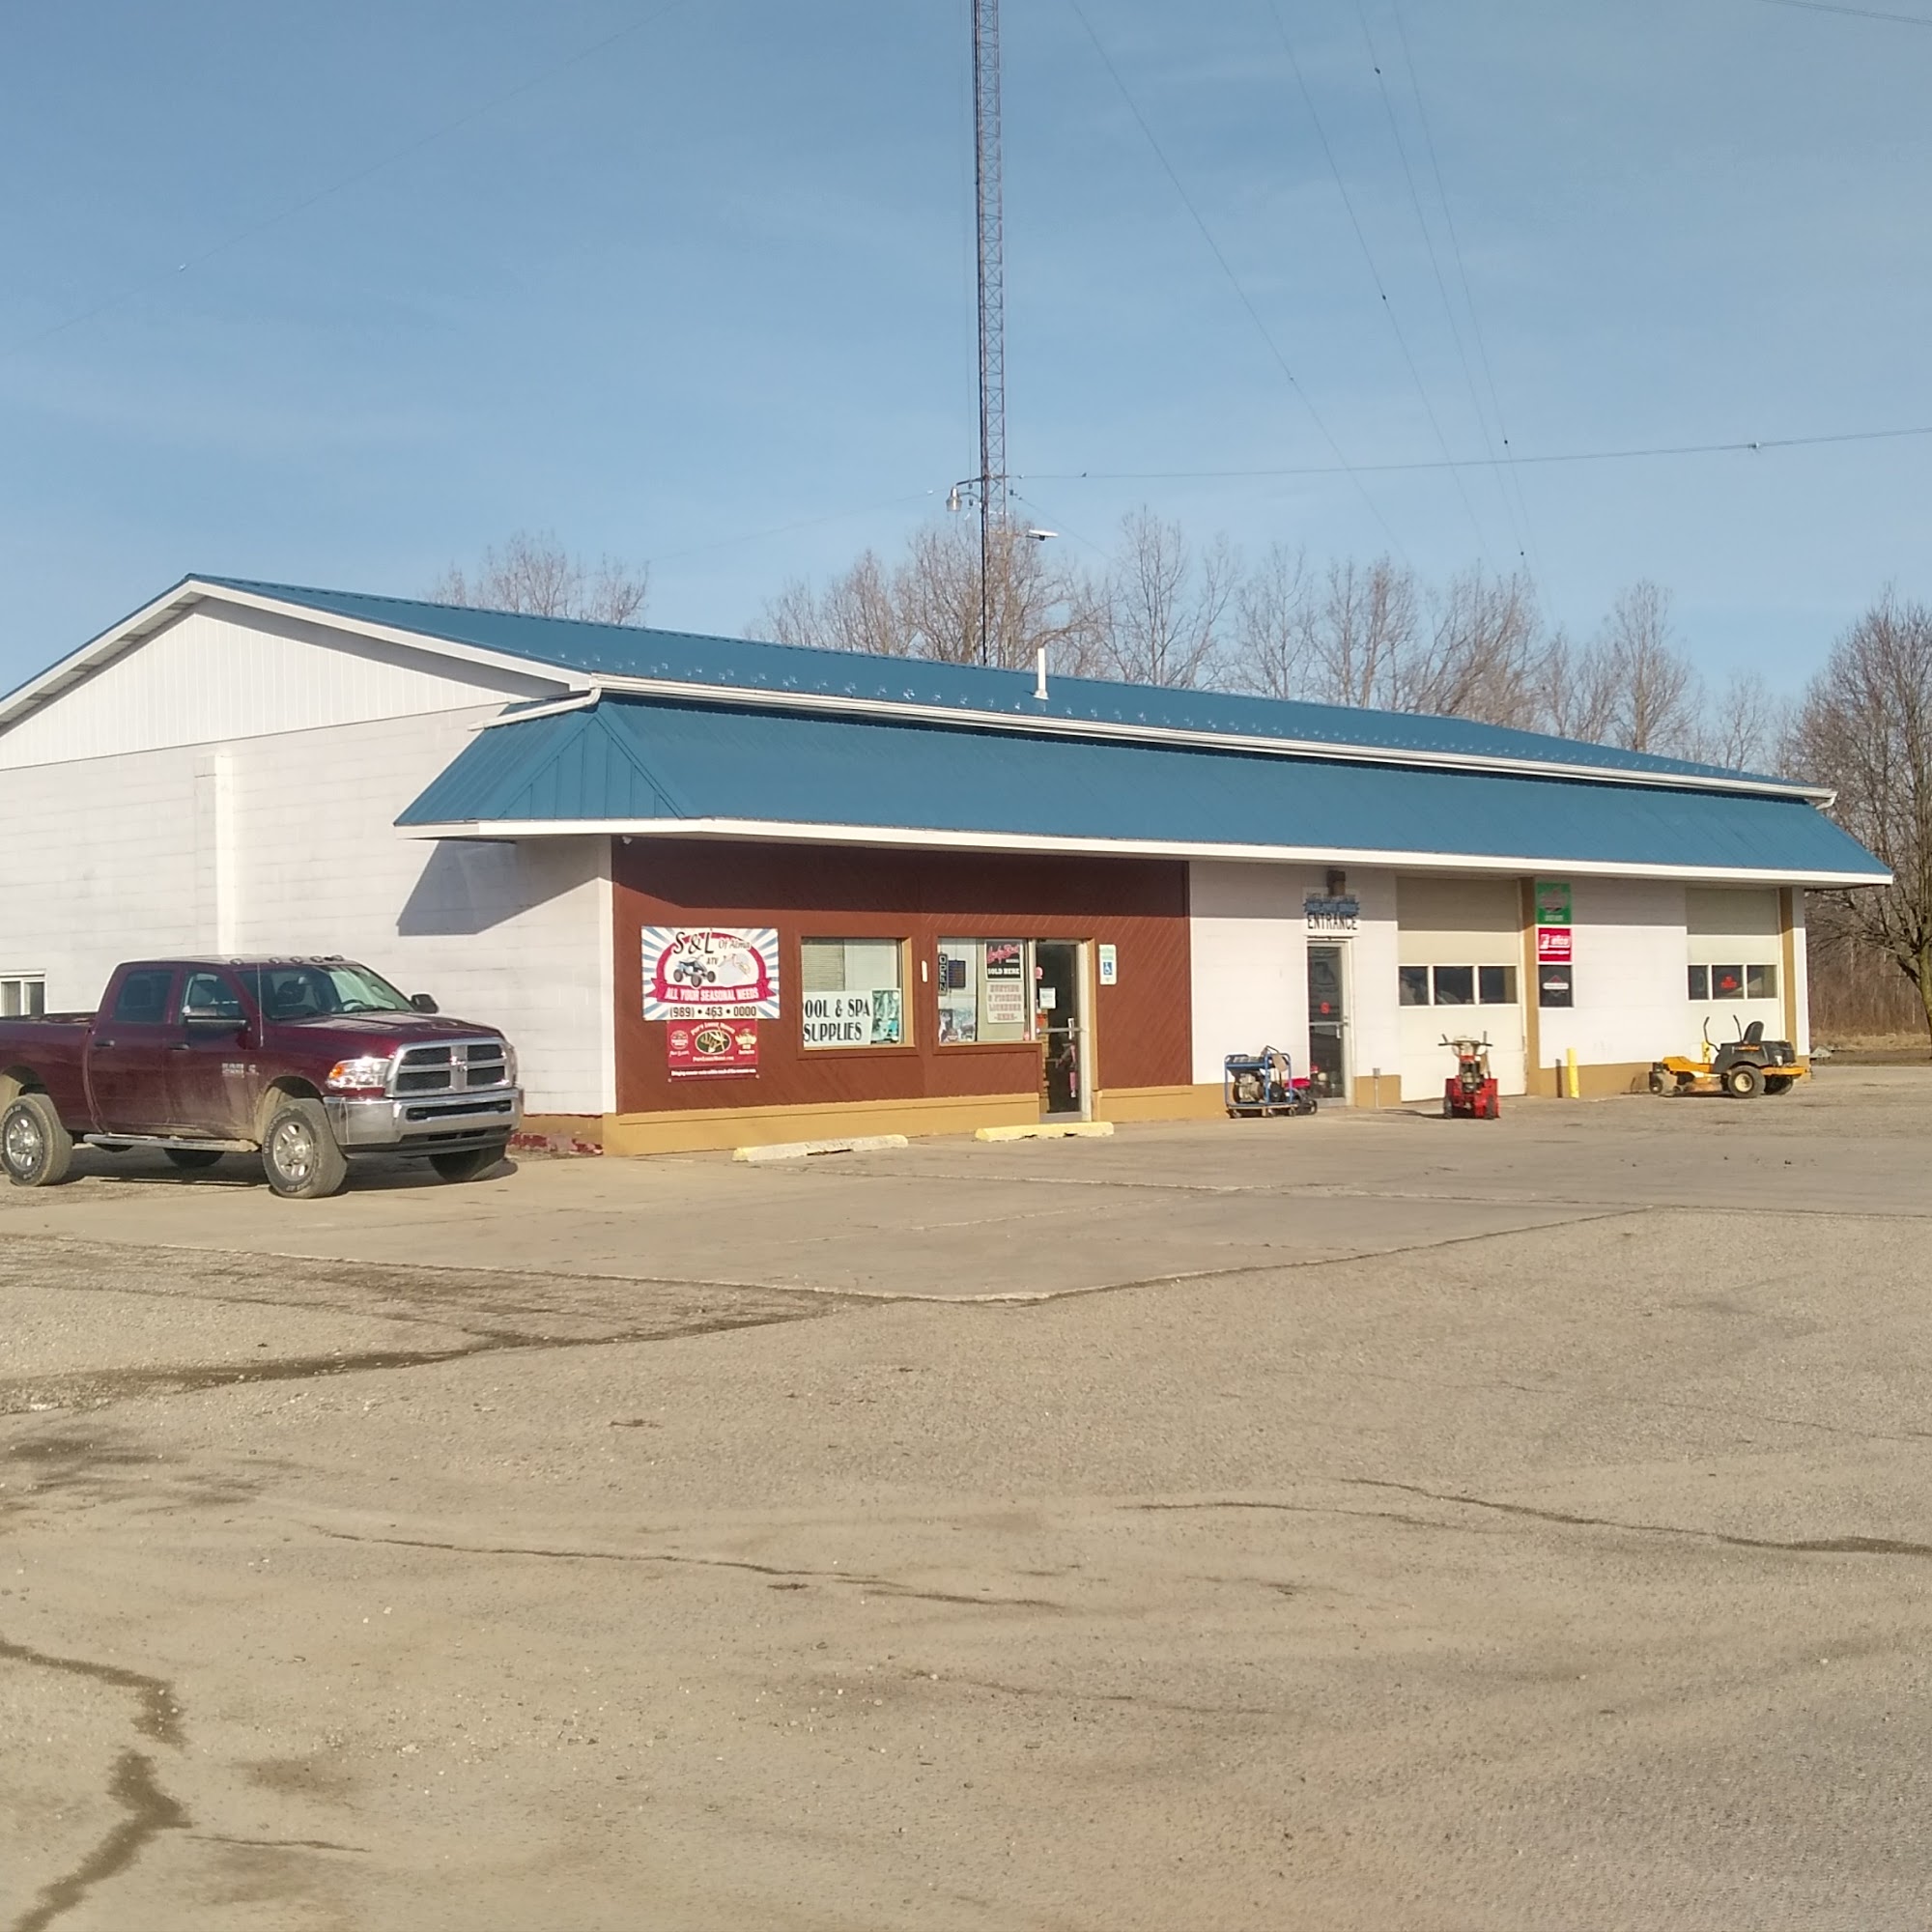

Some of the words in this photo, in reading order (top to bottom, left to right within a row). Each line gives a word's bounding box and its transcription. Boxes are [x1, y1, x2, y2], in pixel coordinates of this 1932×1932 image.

[1307, 913, 1357, 930] ENTRANCE
[673, 931, 685, 954] S
[688, 934, 701, 954] &
[704, 932, 715, 954] L
[665, 987, 678, 1000] ALL
[680, 988, 699, 1001] YOUR
[700, 988, 735, 1002] SEASONAL
[736, 987, 759, 1000] NEEDS
[669, 1007, 695, 1018] (989)
[705, 1007, 723, 1017] 463
[734, 1007, 756, 1017] 0000
[803, 999, 830, 1018] OOL
[835, 999, 842, 1018] &
[848, 998, 870, 1017] SPA
[803, 1022, 863, 1042] SUPPLIES
